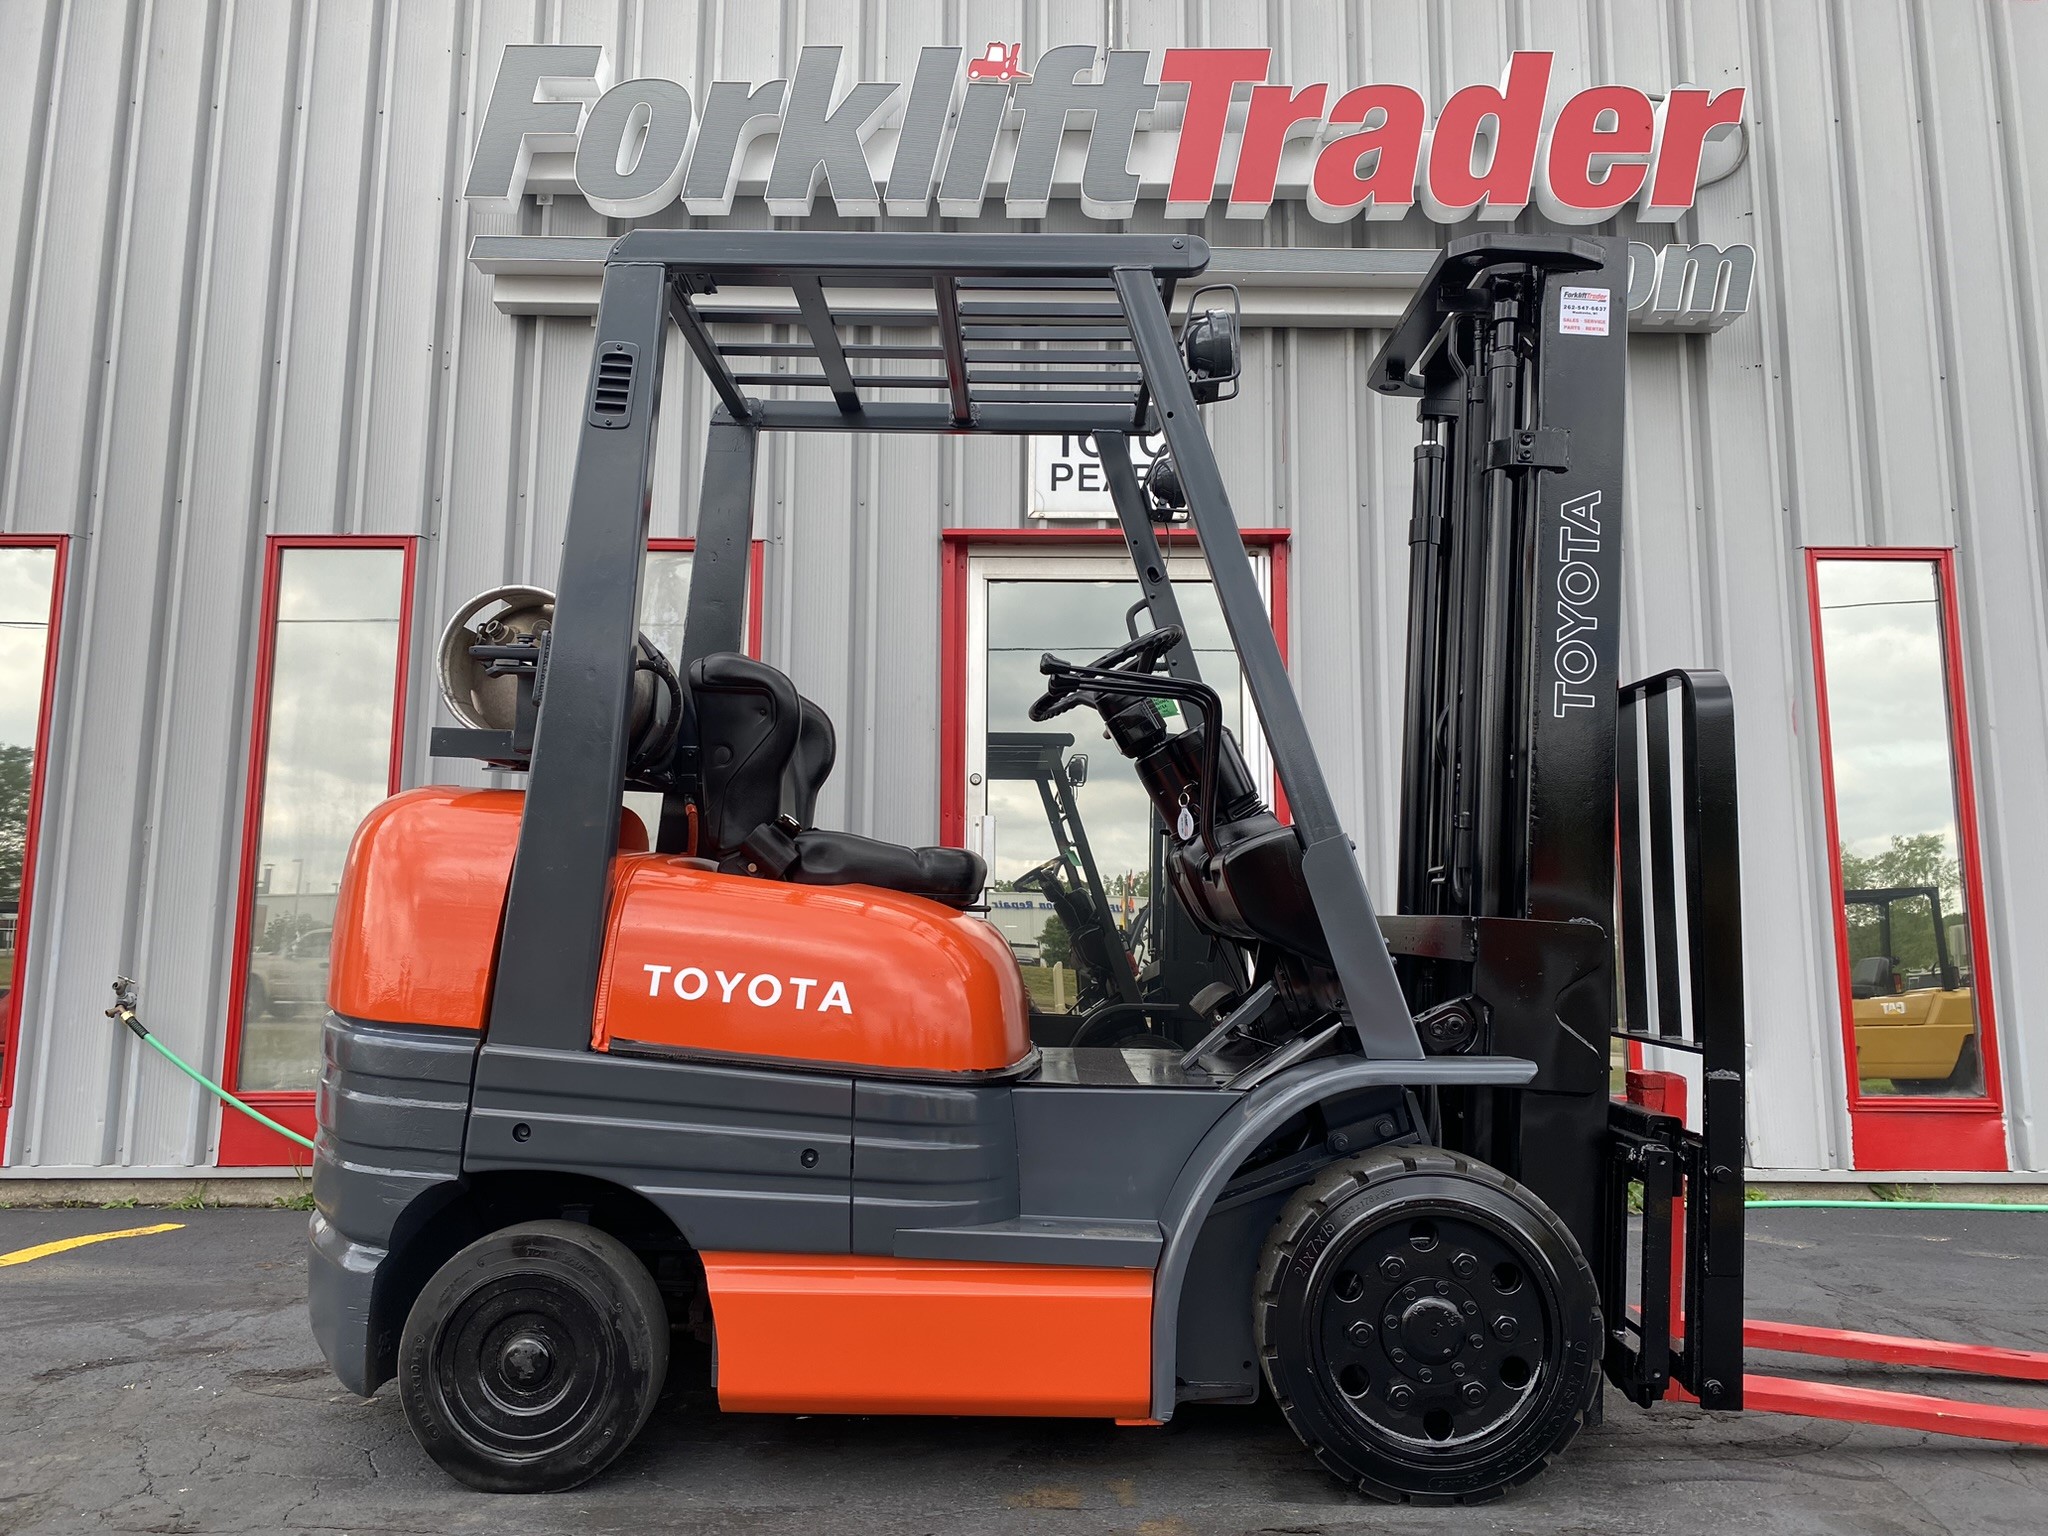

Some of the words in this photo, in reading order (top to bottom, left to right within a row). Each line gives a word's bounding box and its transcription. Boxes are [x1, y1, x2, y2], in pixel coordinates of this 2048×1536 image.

[464, 43, 1747, 211] ForkliftTrader
[1554, 490, 1602, 717] TOYOTA
[643, 963, 853, 1014] TOYOTA
